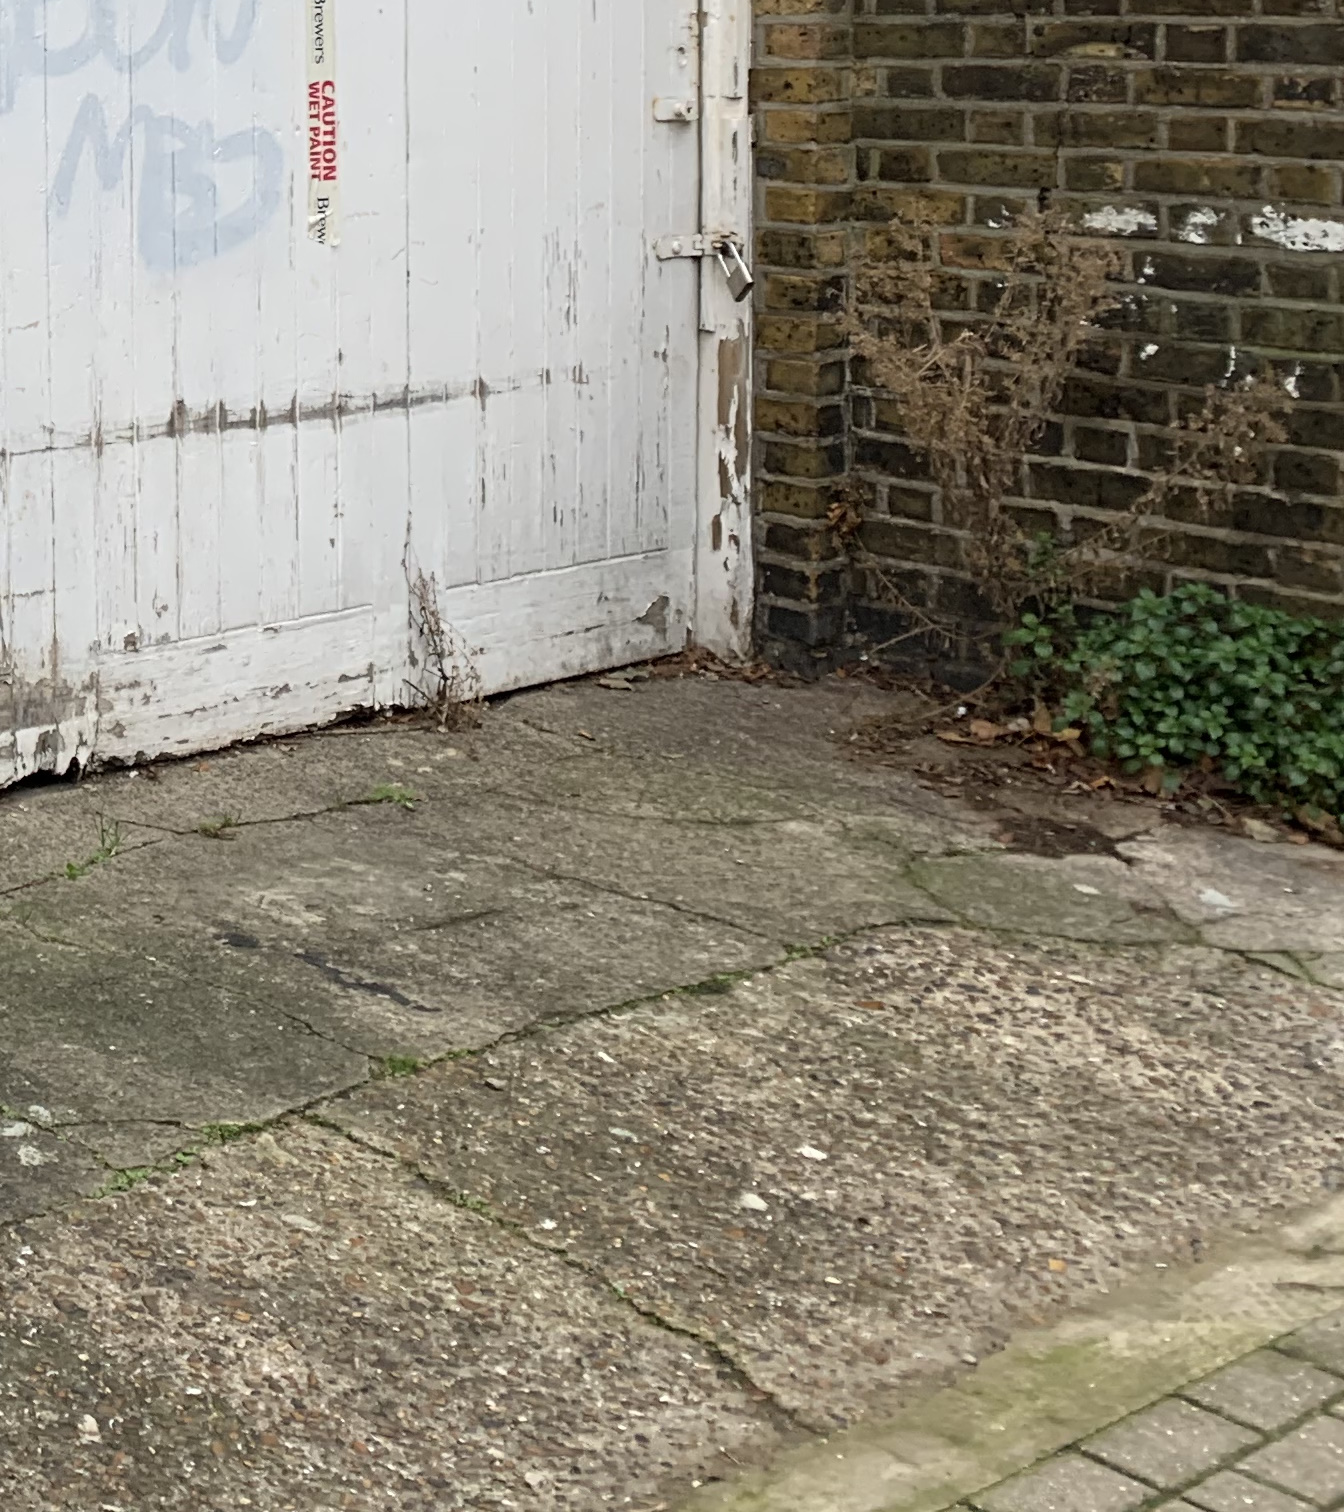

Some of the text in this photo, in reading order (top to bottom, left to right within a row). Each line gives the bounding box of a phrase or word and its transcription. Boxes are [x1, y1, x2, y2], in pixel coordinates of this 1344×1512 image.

[308, 81, 322, 181] WET PAINT
[320, 80, 337, 181] CAUTION
